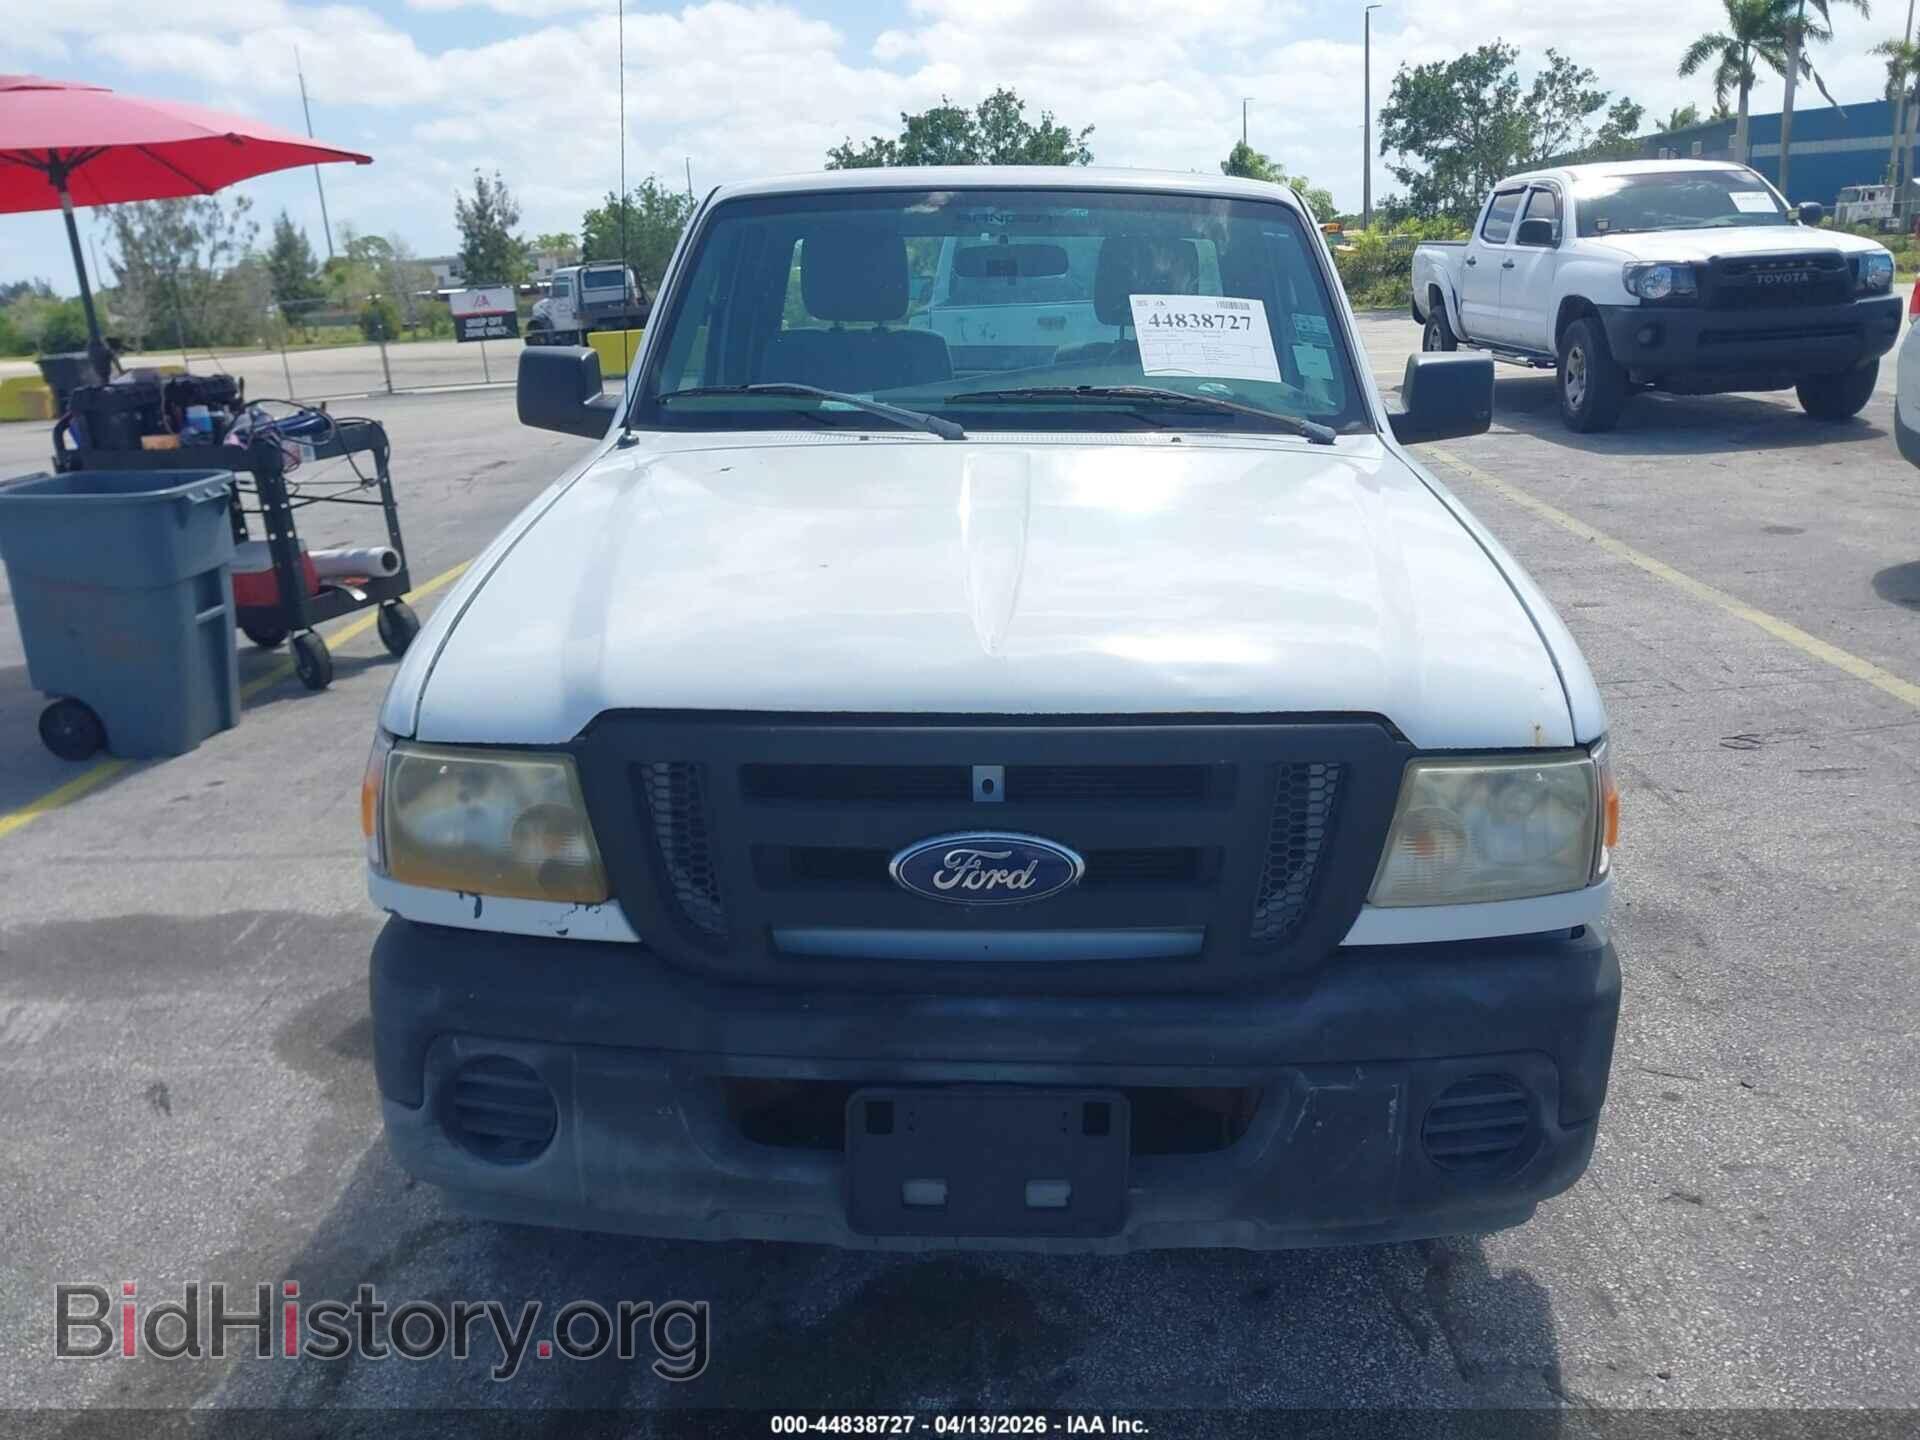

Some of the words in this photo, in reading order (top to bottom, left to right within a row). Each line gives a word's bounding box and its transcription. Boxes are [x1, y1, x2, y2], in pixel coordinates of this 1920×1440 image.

[1757, 272, 1808, 284] TOYOTA
[1148, 313, 1251, 331] 44838727
[933, 848, 1039, 890] Ford
